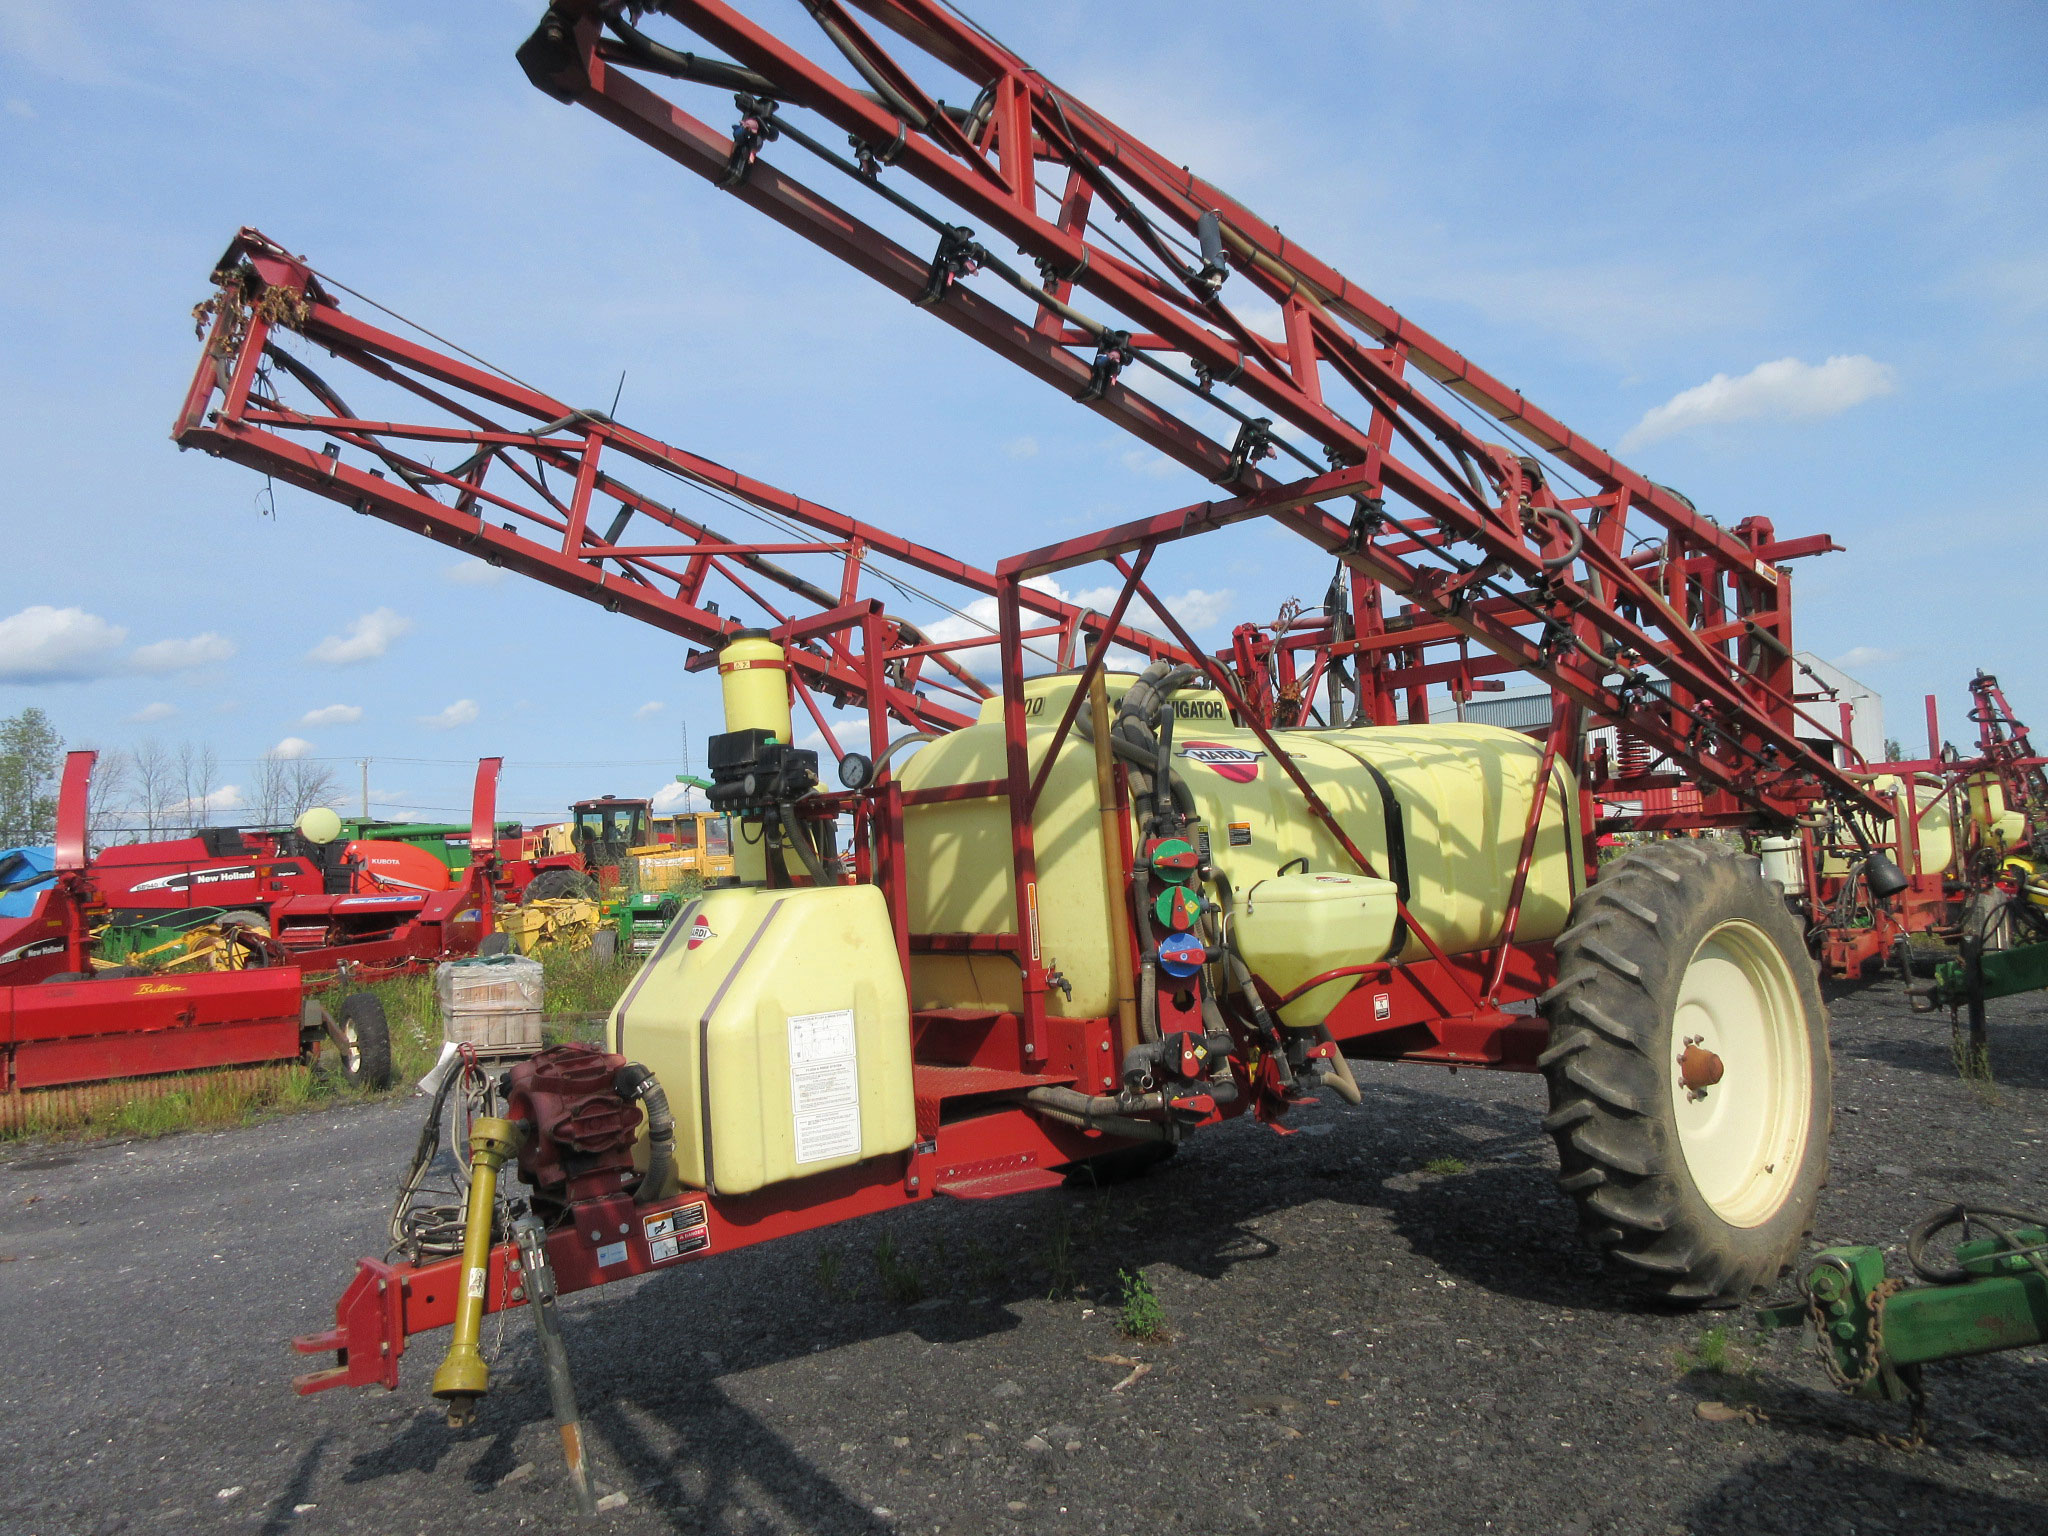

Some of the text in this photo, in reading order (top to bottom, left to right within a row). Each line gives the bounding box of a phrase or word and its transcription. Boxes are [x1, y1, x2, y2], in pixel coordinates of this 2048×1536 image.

[1190, 749, 1252, 760] HARDI
[197, 870, 256, 884] New Holland
[27, 944, 65, 958] New Holland
[133, 983, 188, 995] Brillion
